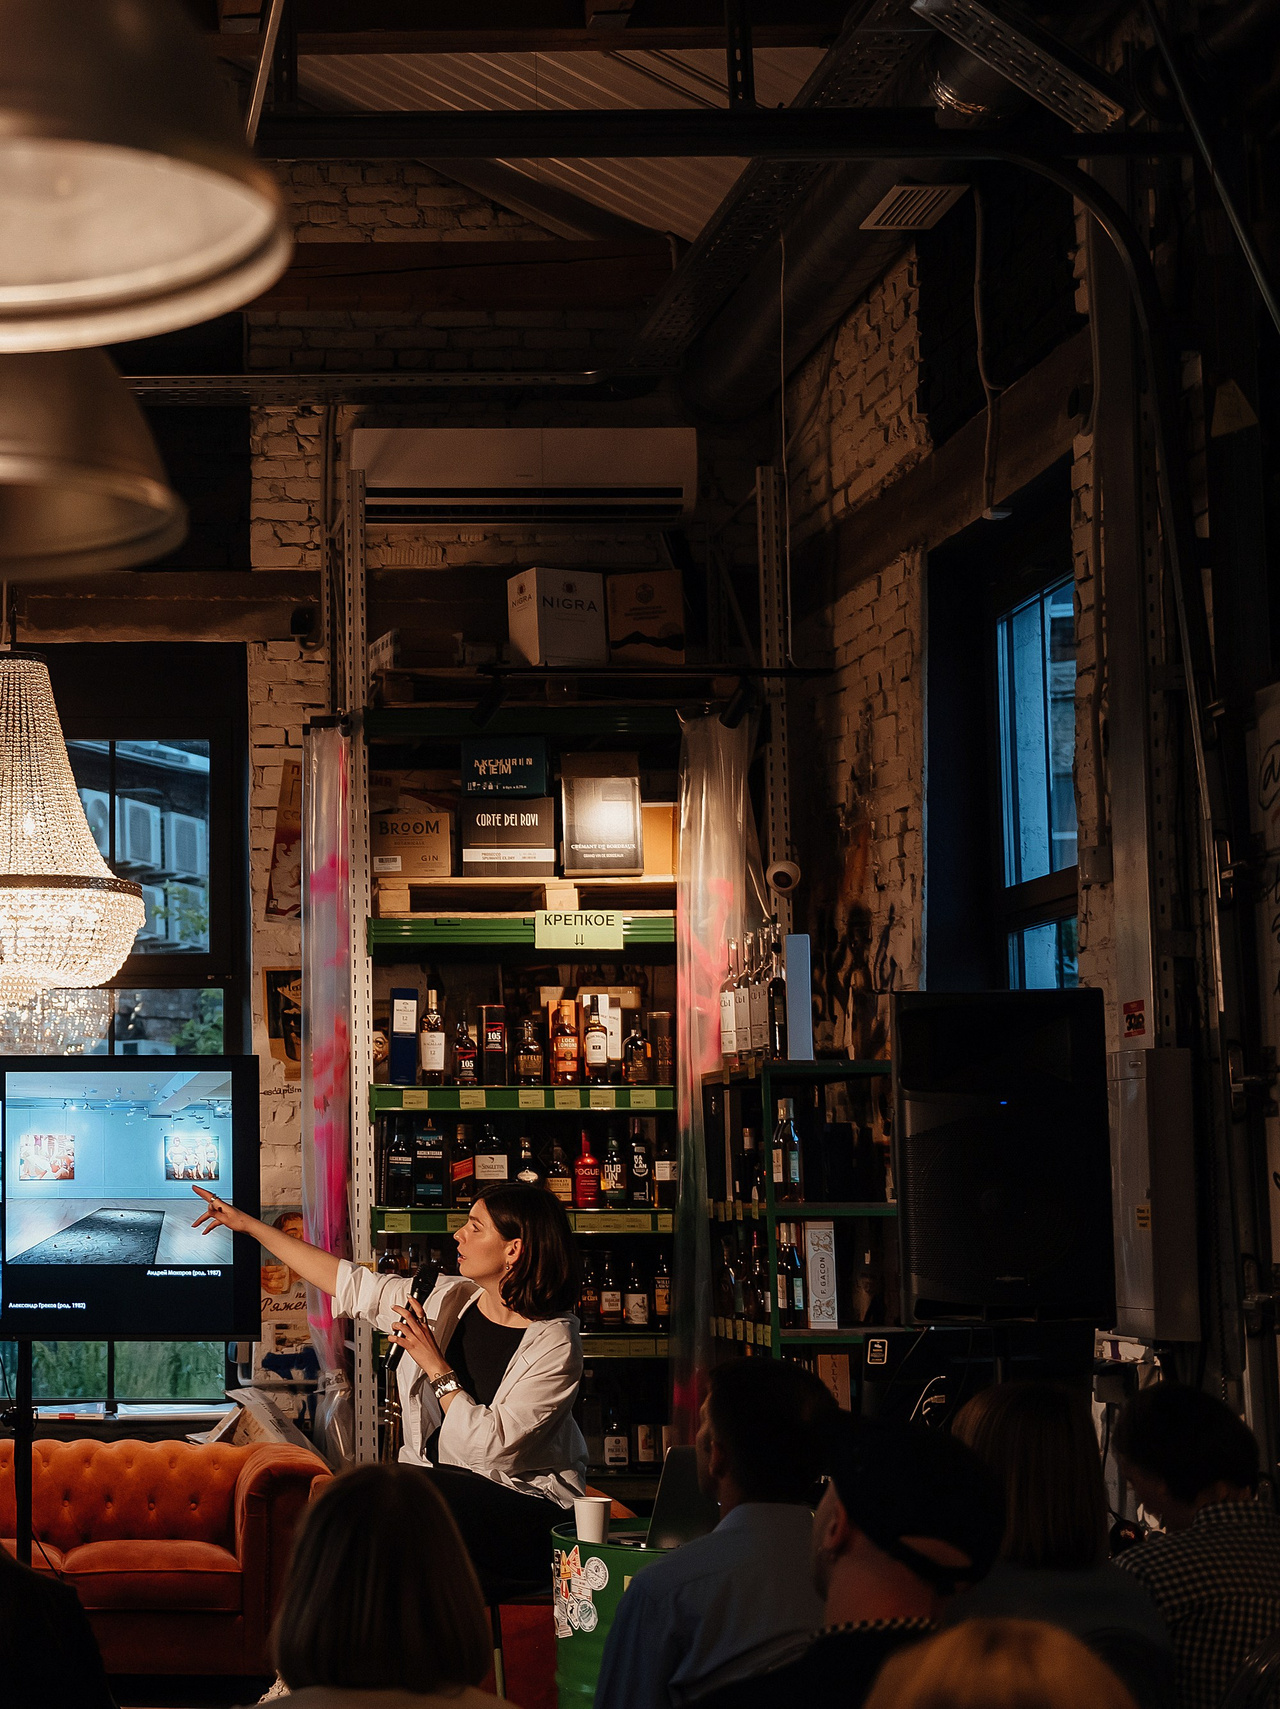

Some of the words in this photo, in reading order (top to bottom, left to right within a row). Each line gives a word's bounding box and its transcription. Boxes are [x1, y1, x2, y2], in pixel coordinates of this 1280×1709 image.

[542, 596, 598, 612] NIGRA
[476, 813, 501, 826] CORTE
[504, 813, 518, 826] DEI
[520, 813, 539, 826] ROVI
[379, 820, 441, 836] BROOM
[544, 914, 615, 926] КРЕПКОЕ
[487, 1032, 501, 1040] 105
[575, 1168, 600, 1176] POGUE
[604, 1164, 621, 1173] DUB
[261, 1297, 308, 1312] Ряжен
